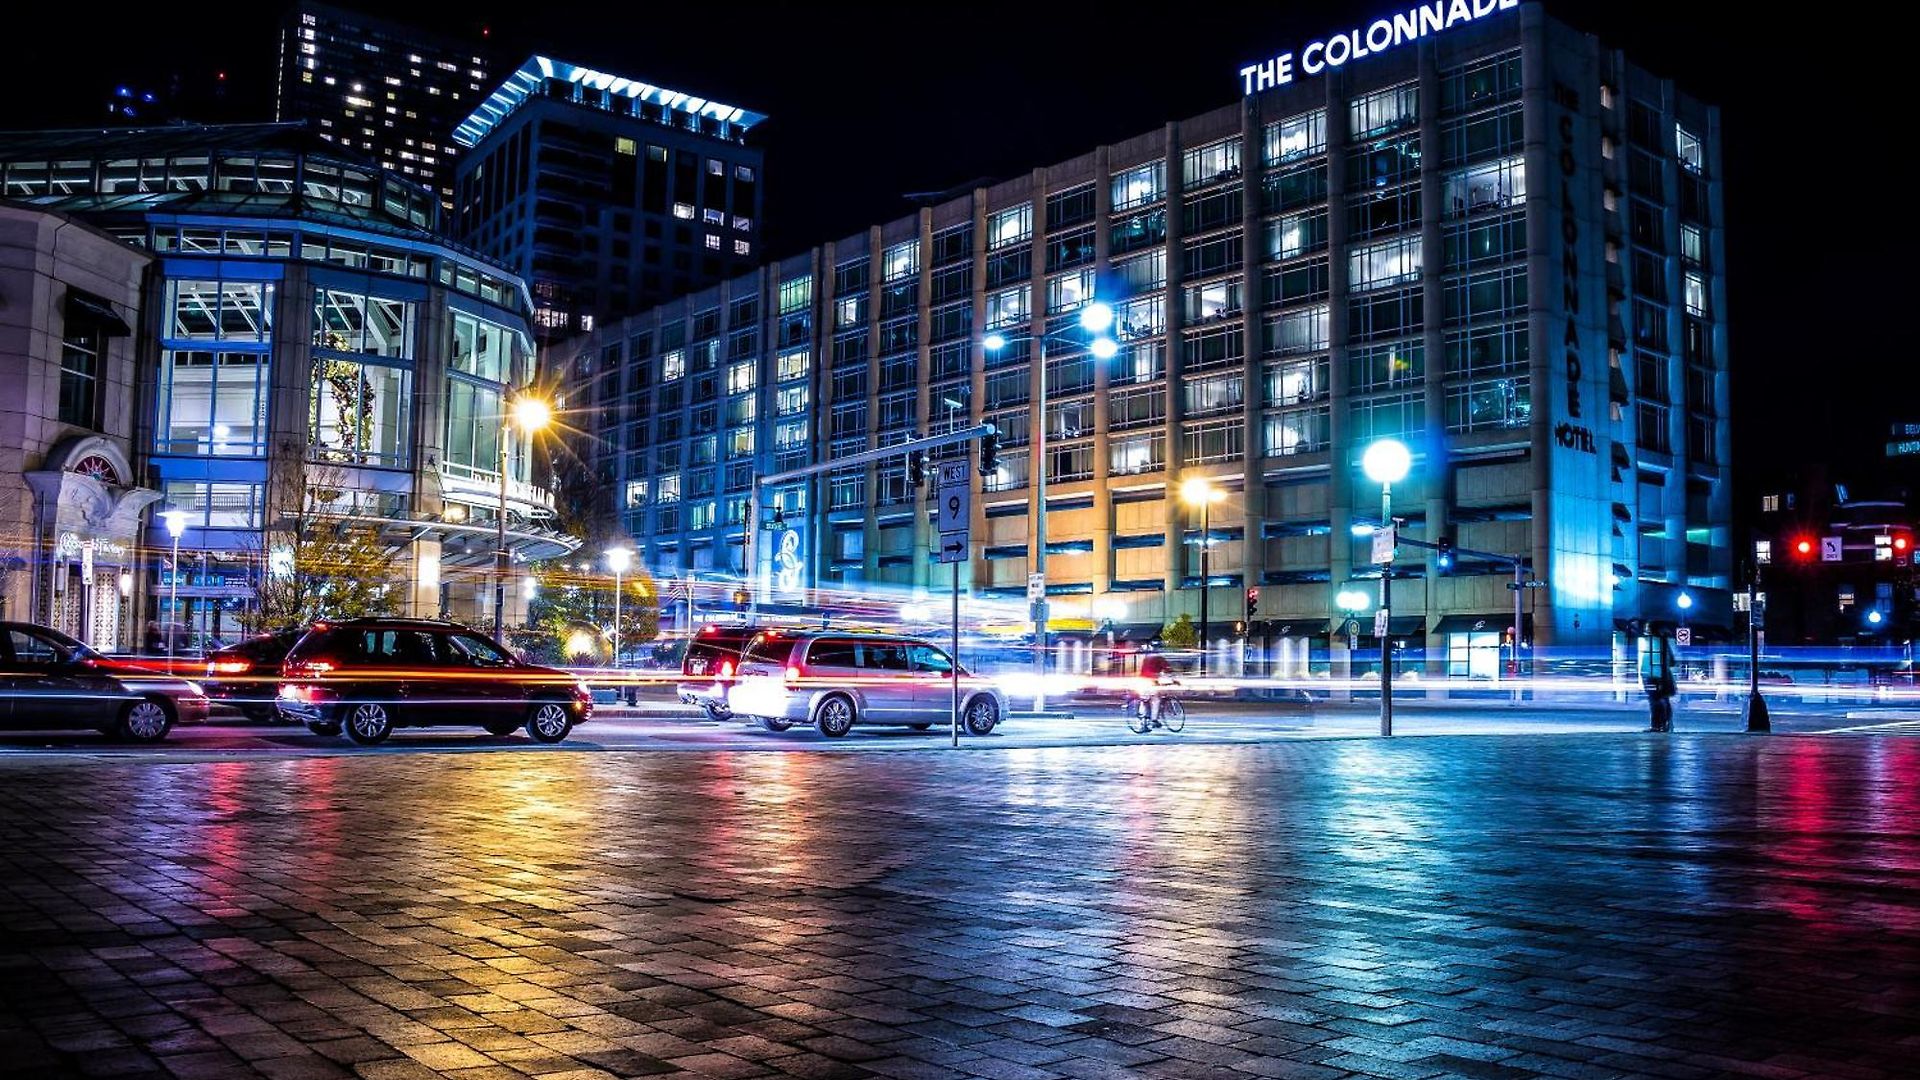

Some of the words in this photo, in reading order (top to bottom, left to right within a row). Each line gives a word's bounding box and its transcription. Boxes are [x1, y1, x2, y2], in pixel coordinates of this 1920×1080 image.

[1240, 53, 1292, 95] THE
[1558, 115, 1581, 418] COLONNADE
[1554, 420, 1597, 455] HOTEL
[944, 465, 966, 481] WEST
[948, 495, 960, 520] 9
